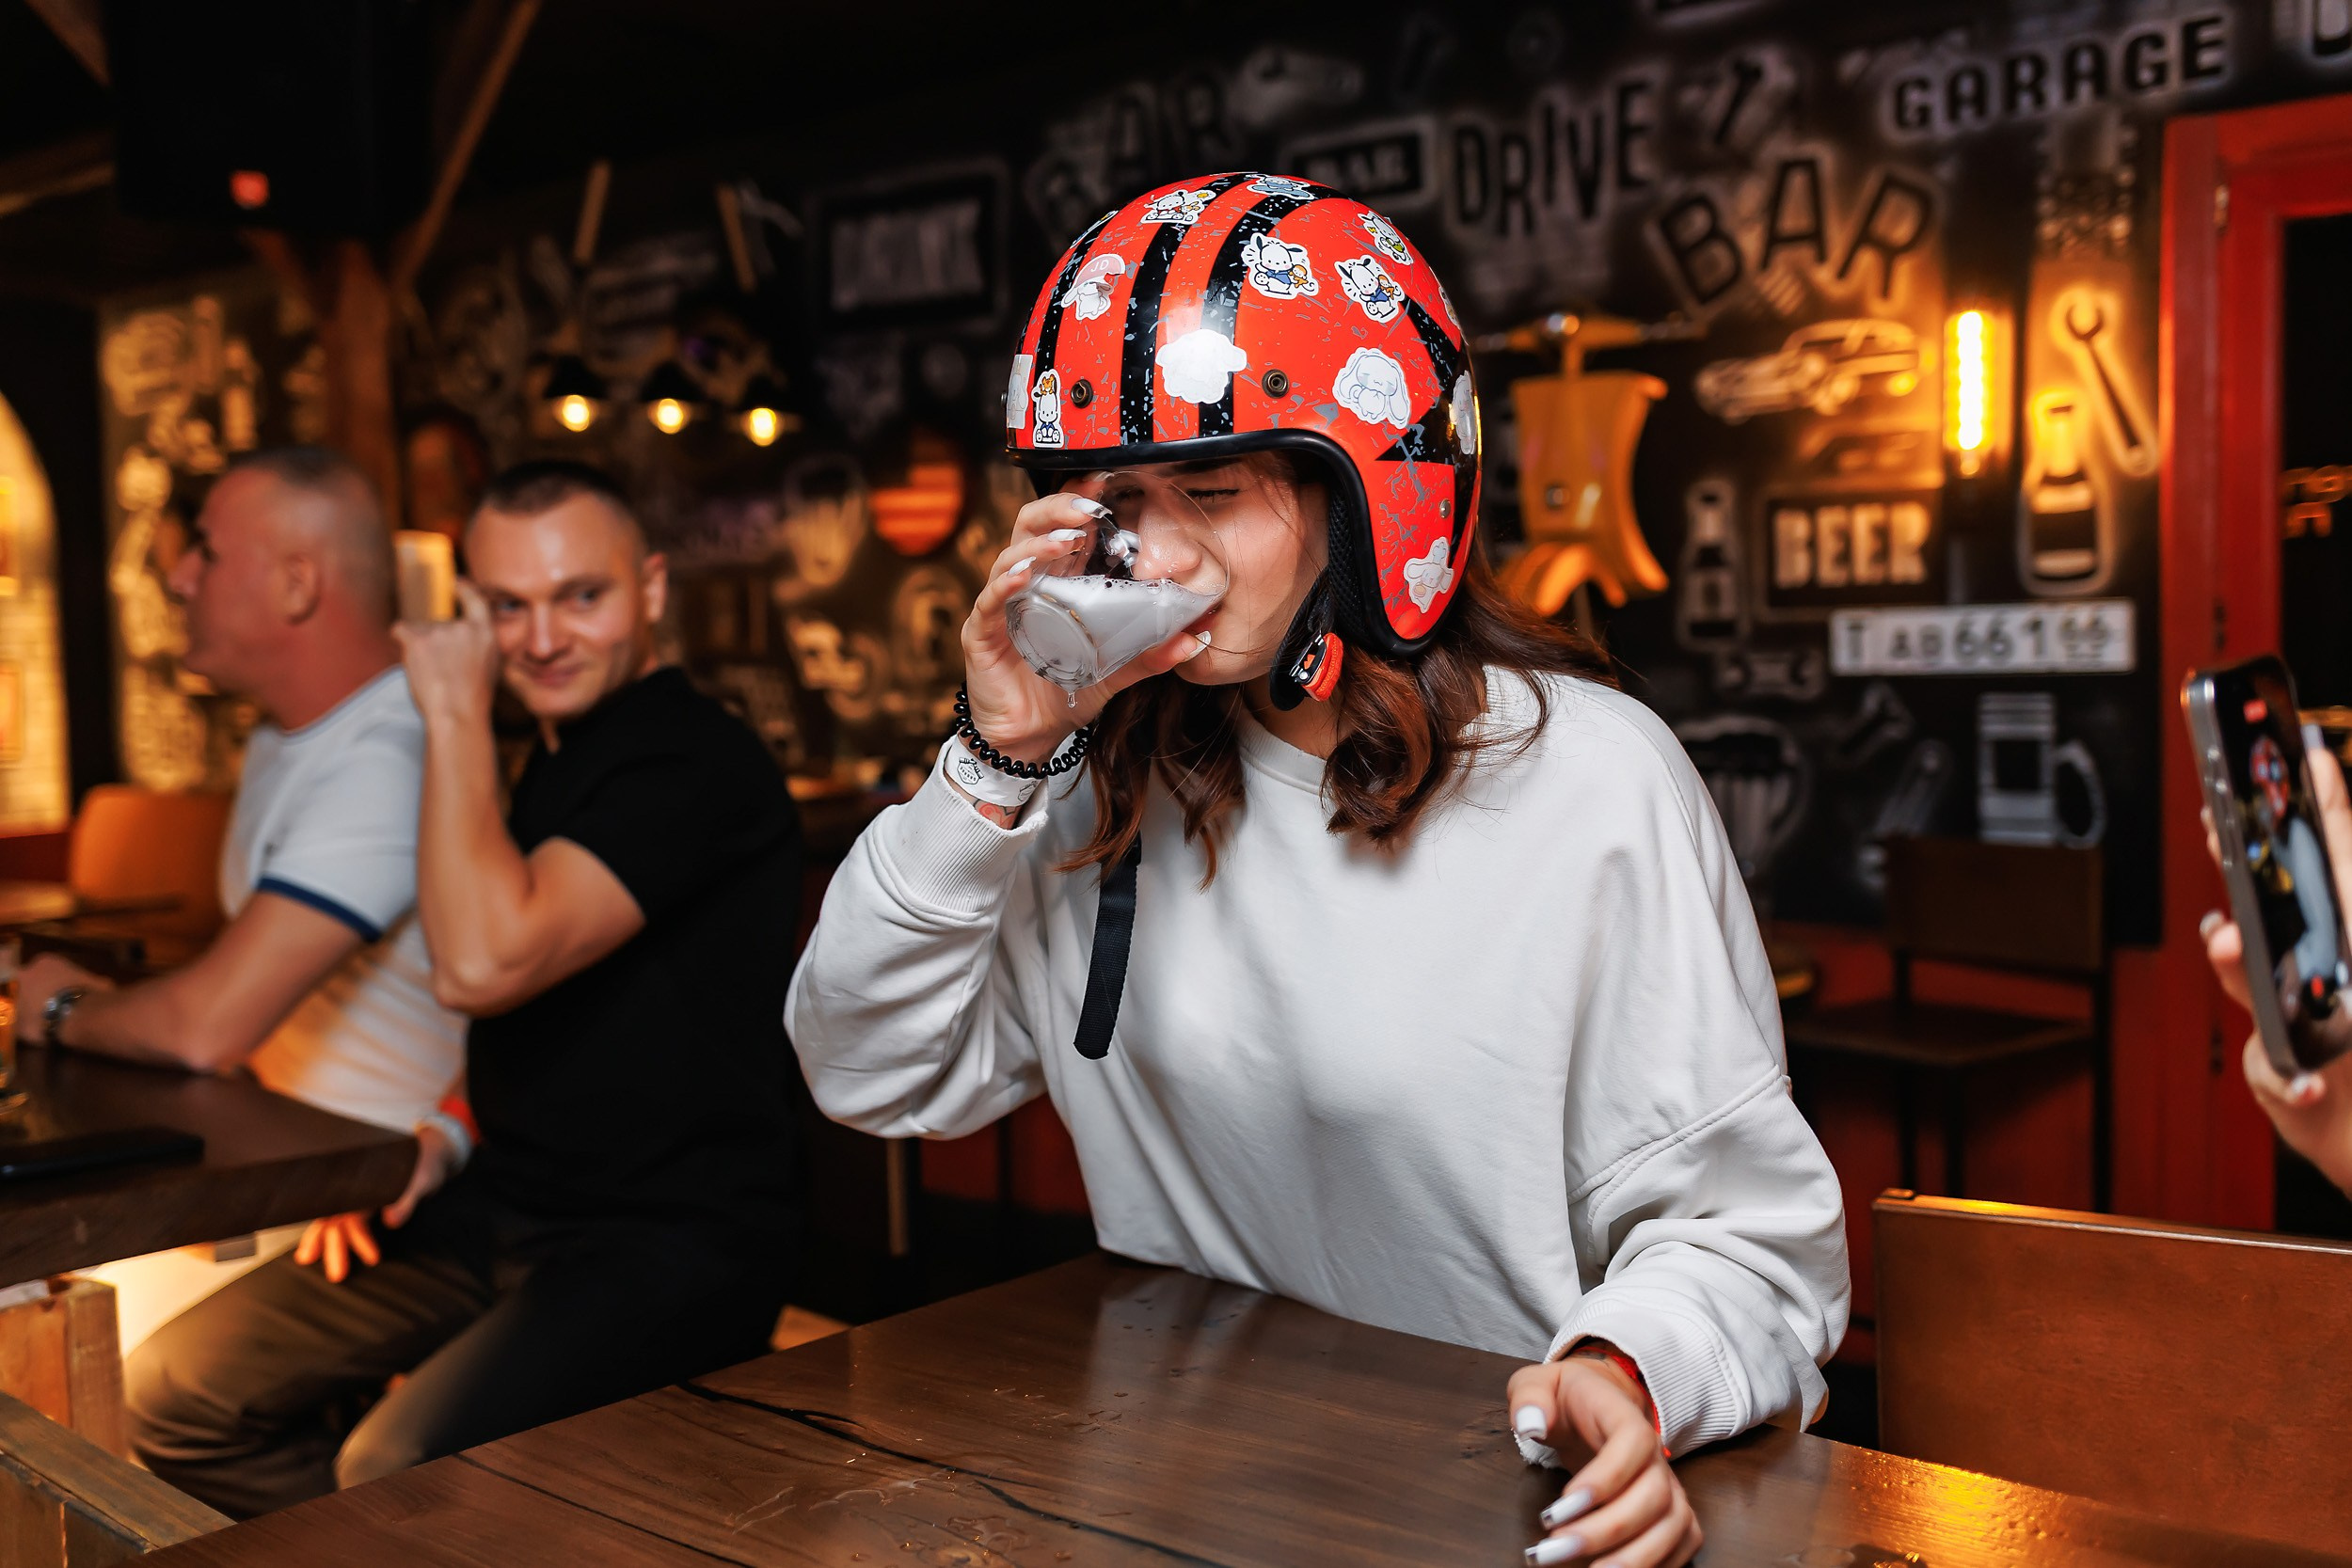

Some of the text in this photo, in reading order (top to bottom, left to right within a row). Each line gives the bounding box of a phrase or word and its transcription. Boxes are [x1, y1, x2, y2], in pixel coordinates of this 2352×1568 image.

[1893, 16, 2225, 132] GARAGE
[1454, 81, 1650, 236] DRIVE
[1660, 157, 1931, 305] BAR
[1773, 500, 1930, 589] BEER
